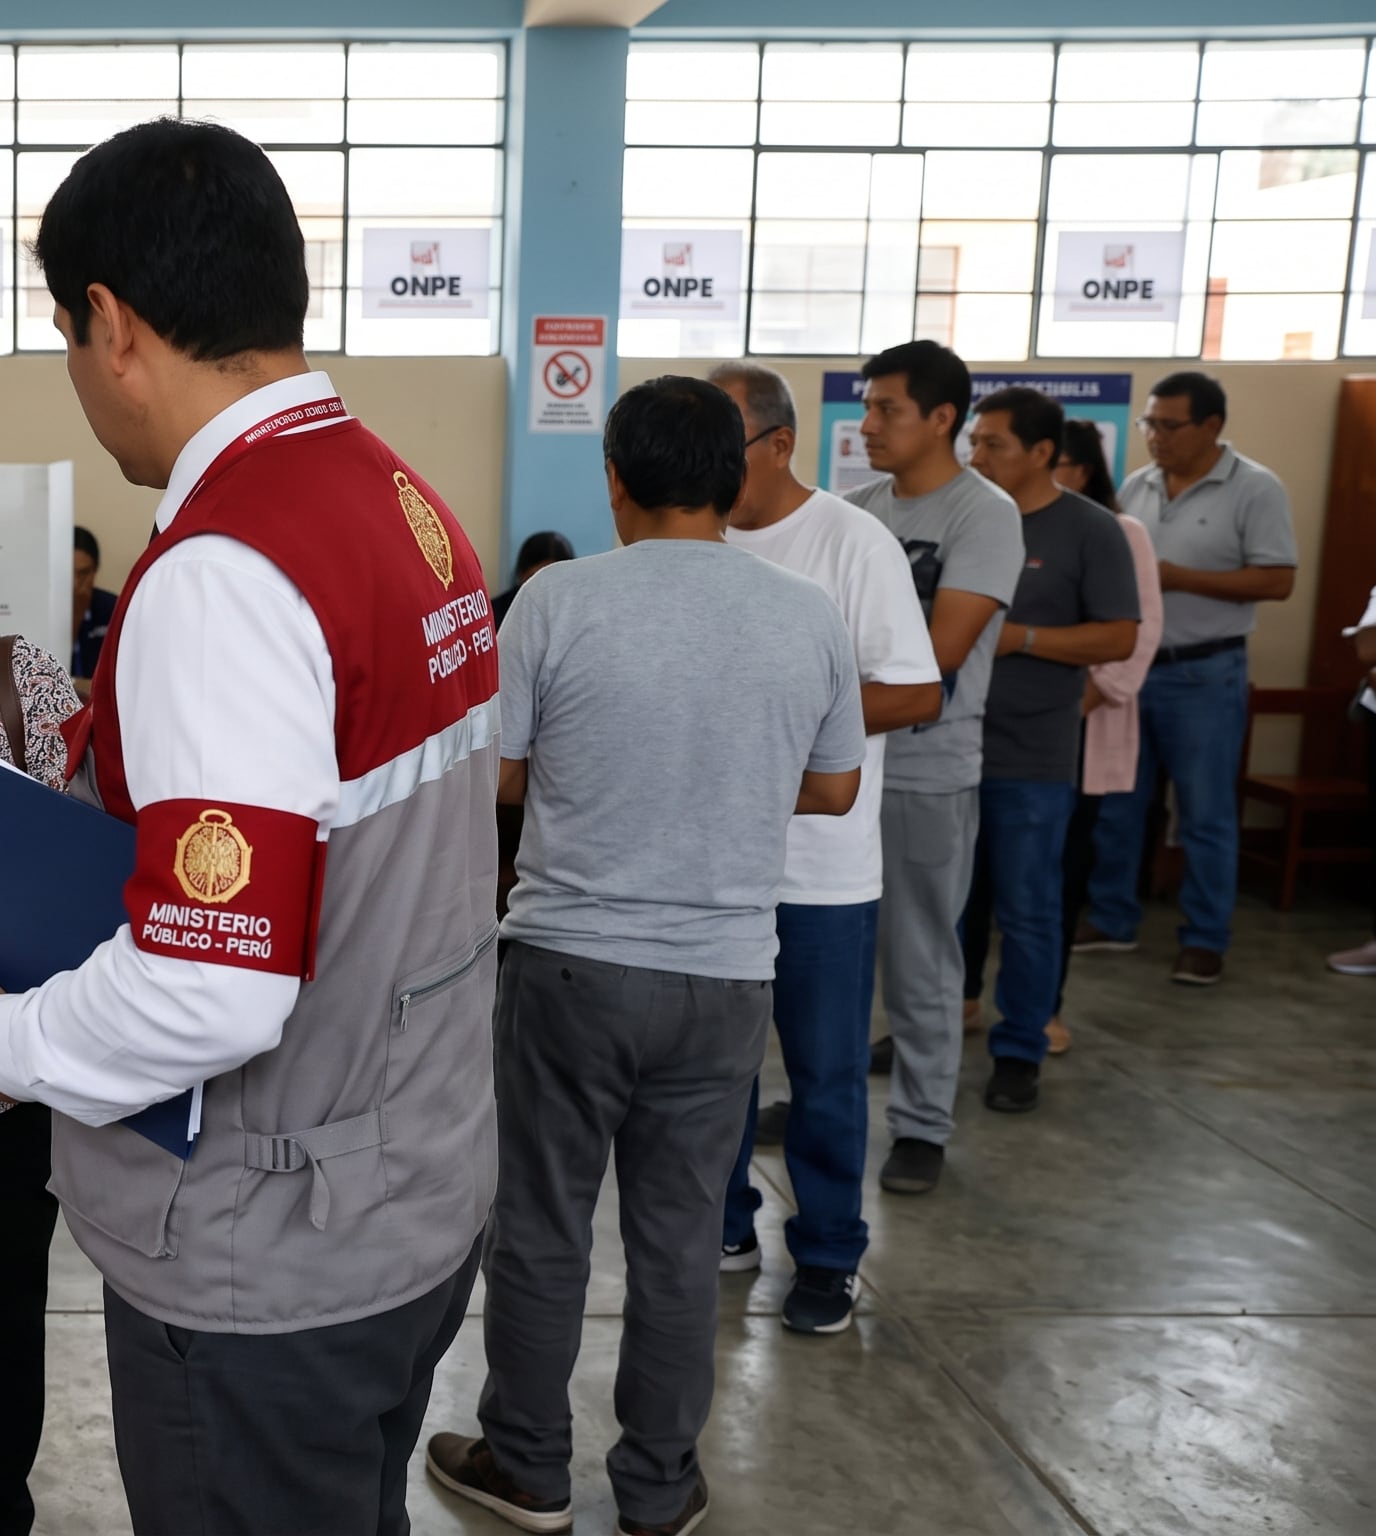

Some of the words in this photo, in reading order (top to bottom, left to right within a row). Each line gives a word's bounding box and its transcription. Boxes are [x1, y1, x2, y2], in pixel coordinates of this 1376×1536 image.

[391, 276, 462, 296] ONPE
[643, 277, 713, 298] ONPE
[1082, 279, 1156, 300] ONPE
[148, 902, 271, 937] MINISTERIO
[142, 923, 212, 950] PÚBLICO
[226, 937, 272, 960] PERÚ
